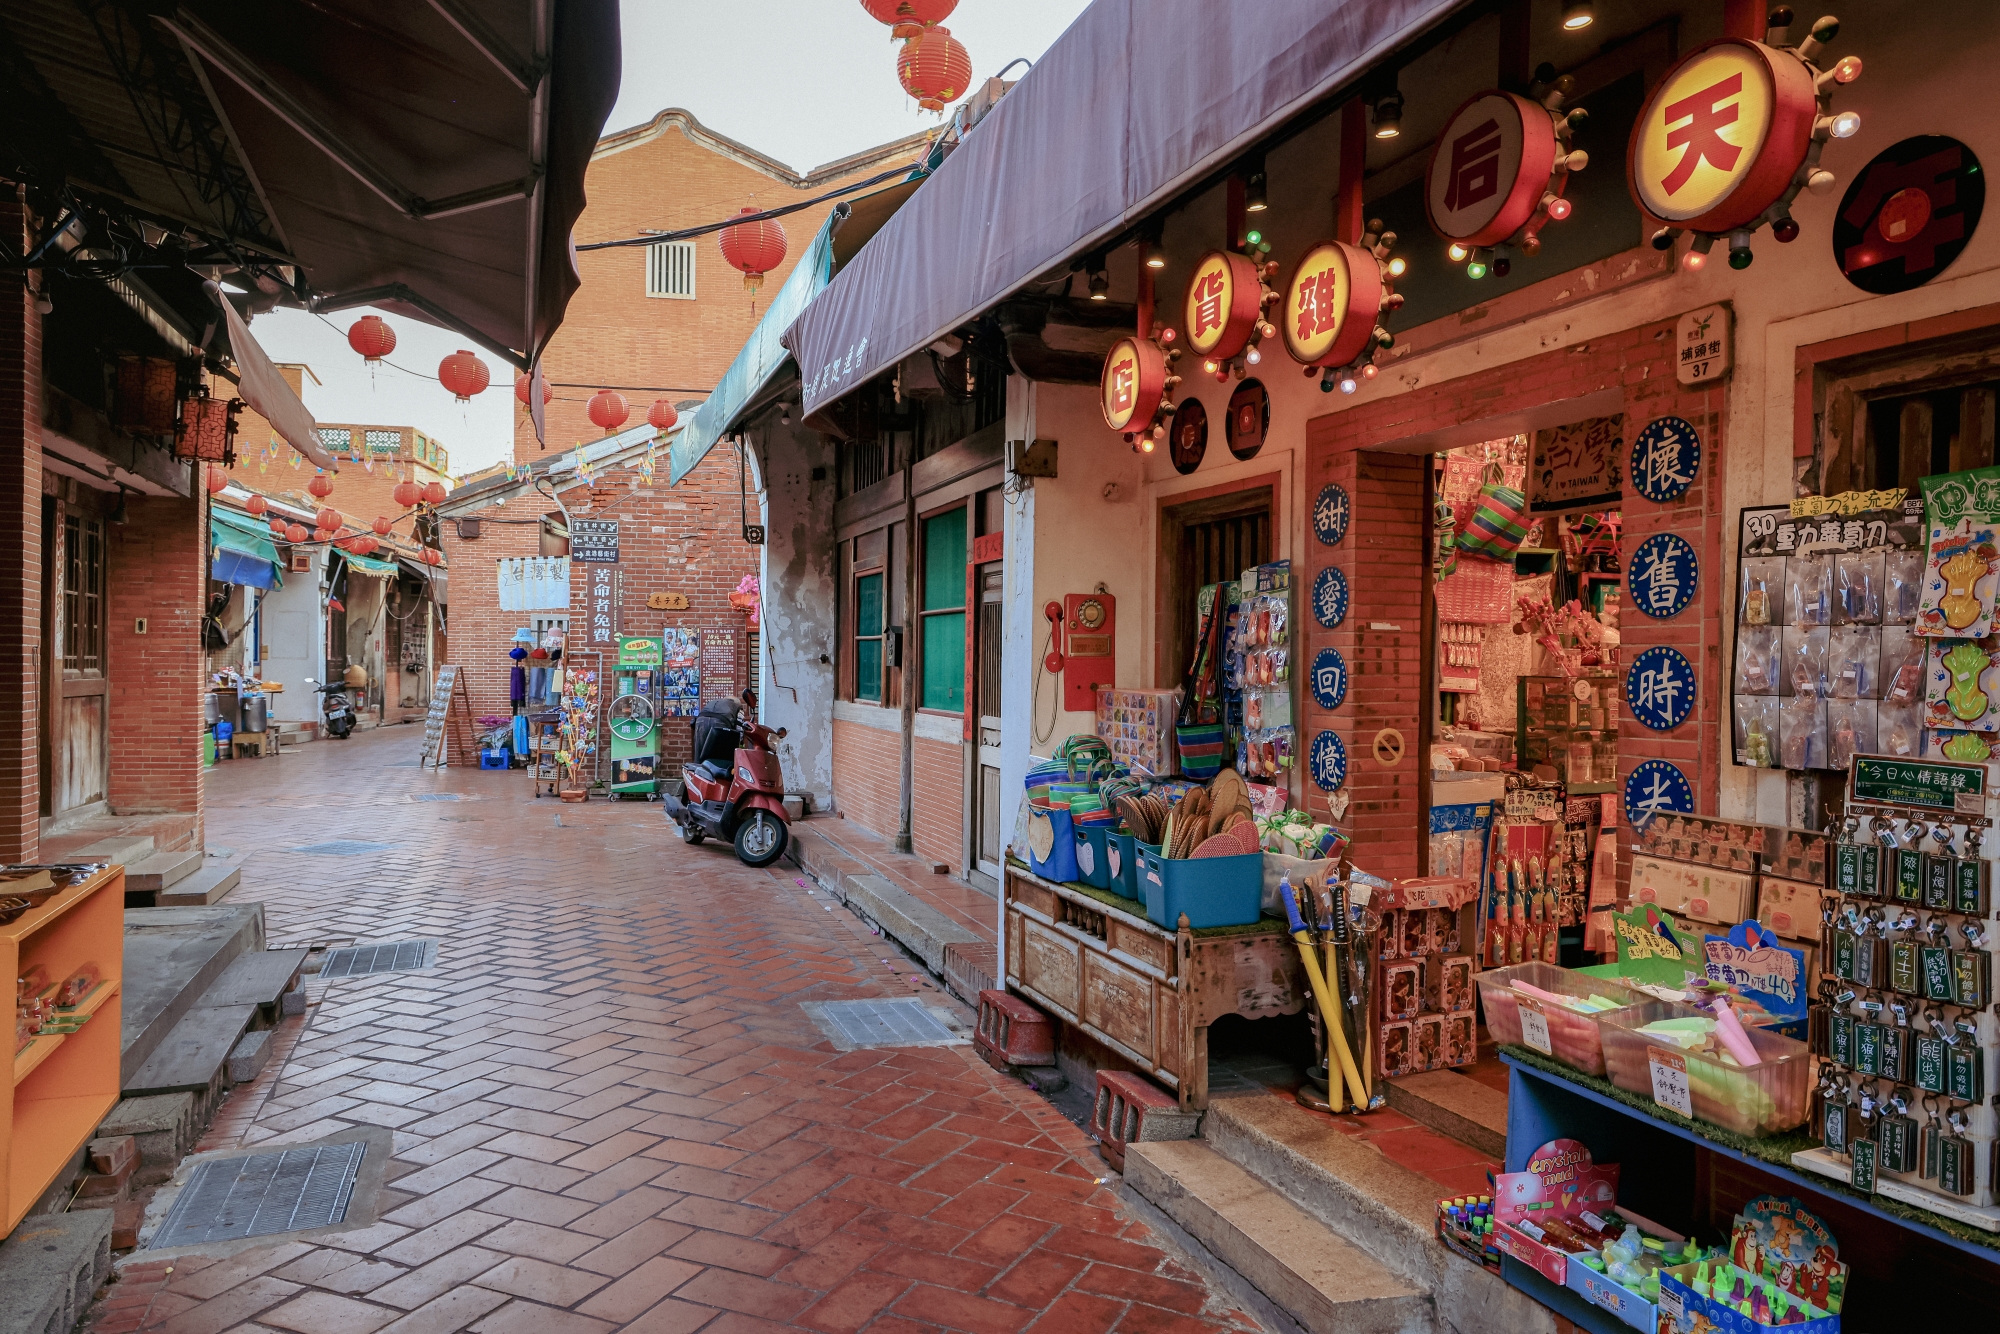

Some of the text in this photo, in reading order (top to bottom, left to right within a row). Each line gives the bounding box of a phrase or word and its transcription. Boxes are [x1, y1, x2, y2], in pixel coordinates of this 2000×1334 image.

[1112, 72, 1743, 414] 天 后 雜 貨 店
[1681, 340, 1720, 361] 埔頭街
[1693, 362, 1709, 377] 37
[1640, 428, 1691, 493] 懷
[1568, 475, 1599, 488] TAIWAN
[1747, 515, 1776, 538] 3D
[513, 564, 564, 581] 台灣製
[1638, 541, 1682, 609] 舊
[593, 568, 611, 642] 苦命者免費
[1315, 497, 1344, 783] 甜 蜜 回 憶
[1637, 658, 1682, 720] 時
[1870, 765, 1967, 788] 今日心情語錄
[1932, 866, 1946, 899] 別煩我
[1963, 868, 1975, 899] 很幸福
[1840, 939, 1850, 970] 小鮮肉
[1530, 1146, 1586, 1175] crystal
[1542, 1164, 1575, 1187] mud
[1757, 1201, 1830, 1242] ANIMAL BUBBLE
